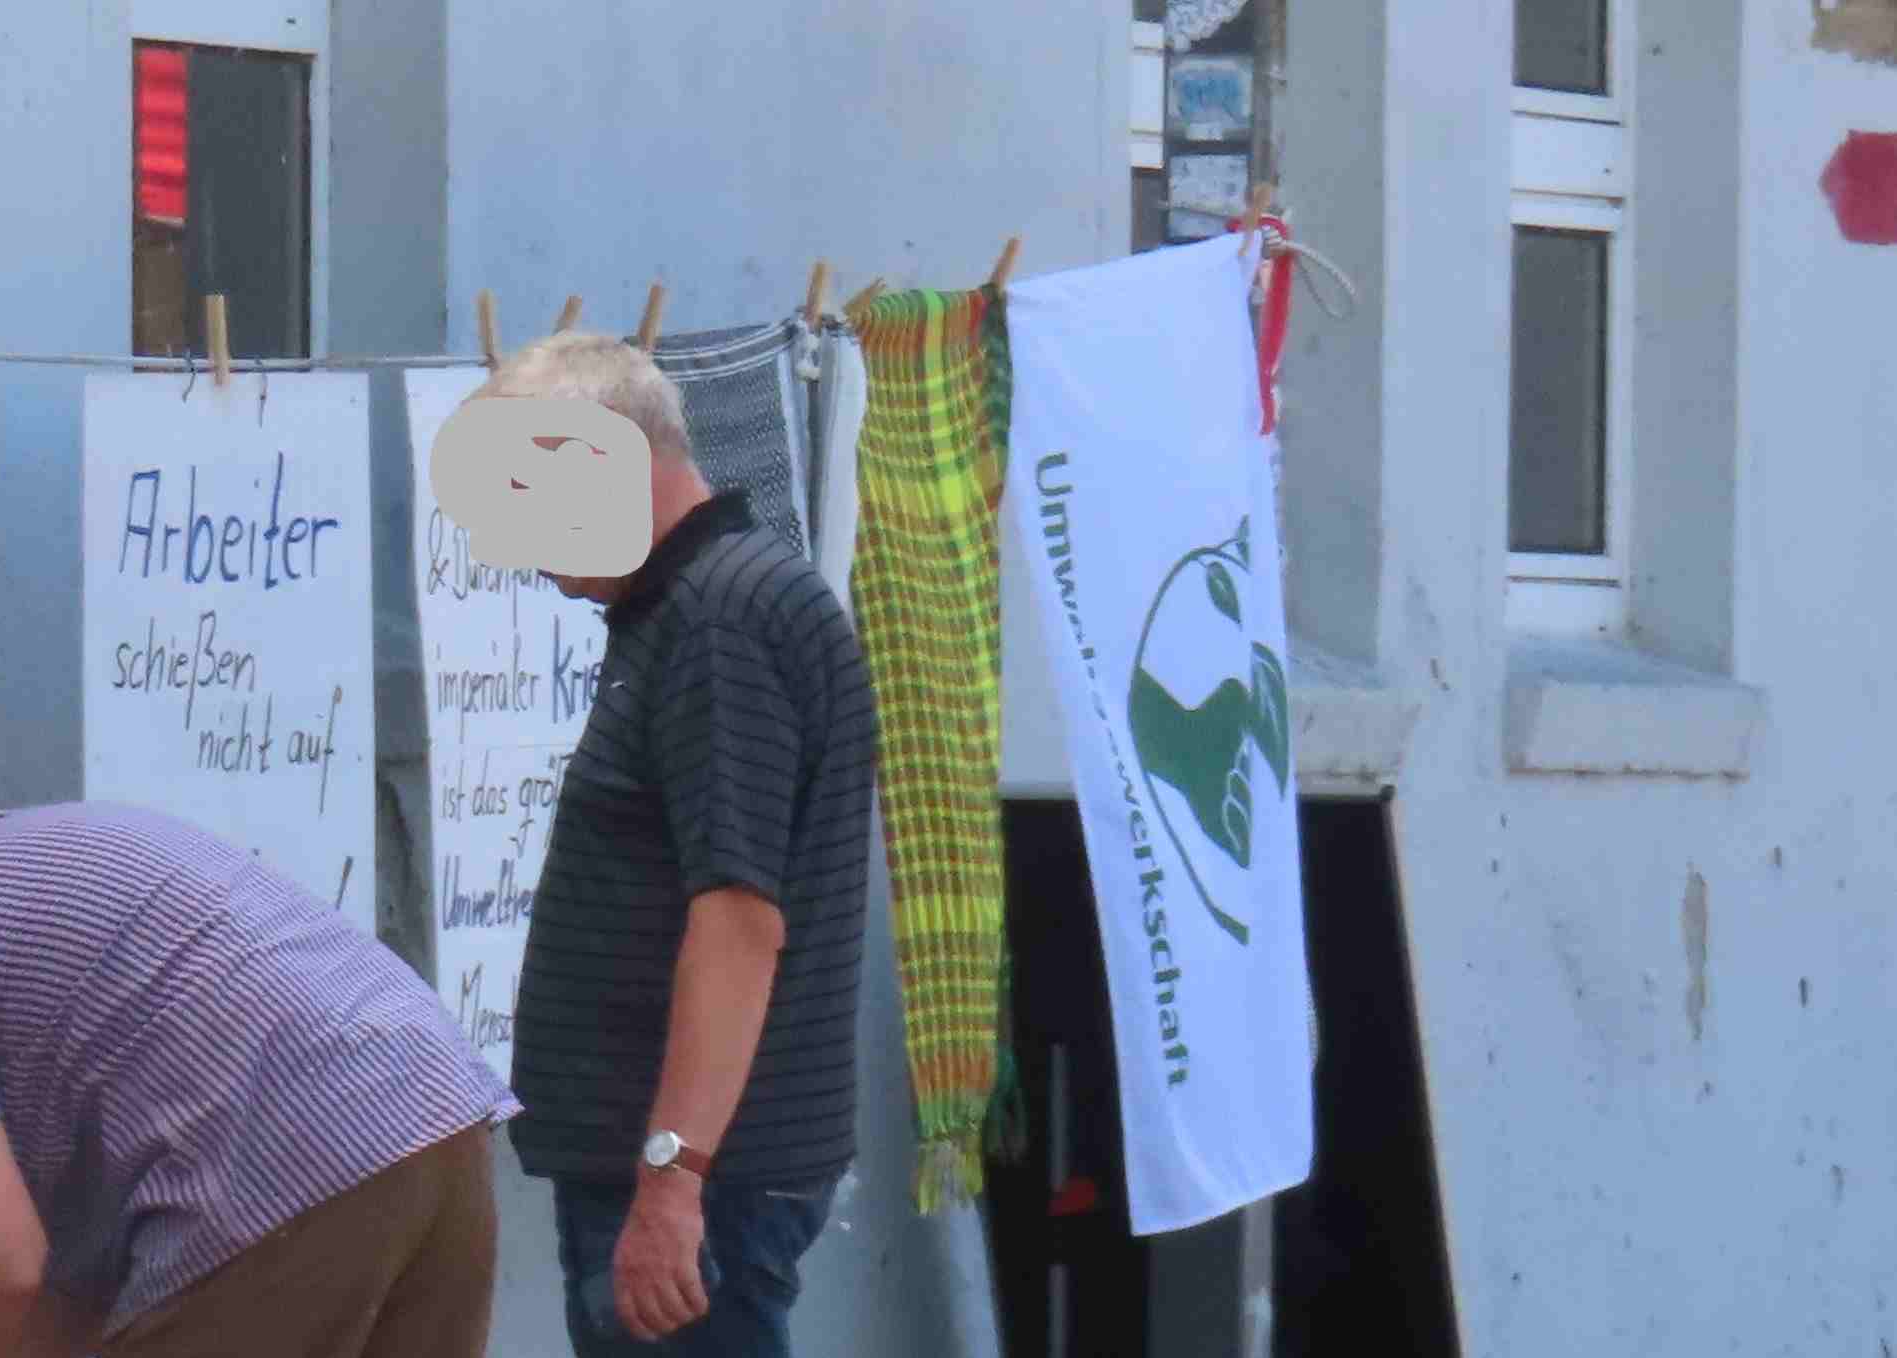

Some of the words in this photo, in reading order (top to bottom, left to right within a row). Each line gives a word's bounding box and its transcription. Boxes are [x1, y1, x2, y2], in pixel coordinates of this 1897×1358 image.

[118, 450, 340, 591] Arbeiter
[111, 609, 257, 732] schießen
[438, 632, 541, 747] imperialer
[554, 613, 604, 725] Krie
[198, 693, 274, 775] nicht
[286, 684, 345, 816] auf
[442, 759, 465, 823] ist
[472, 749, 509, 816] das
